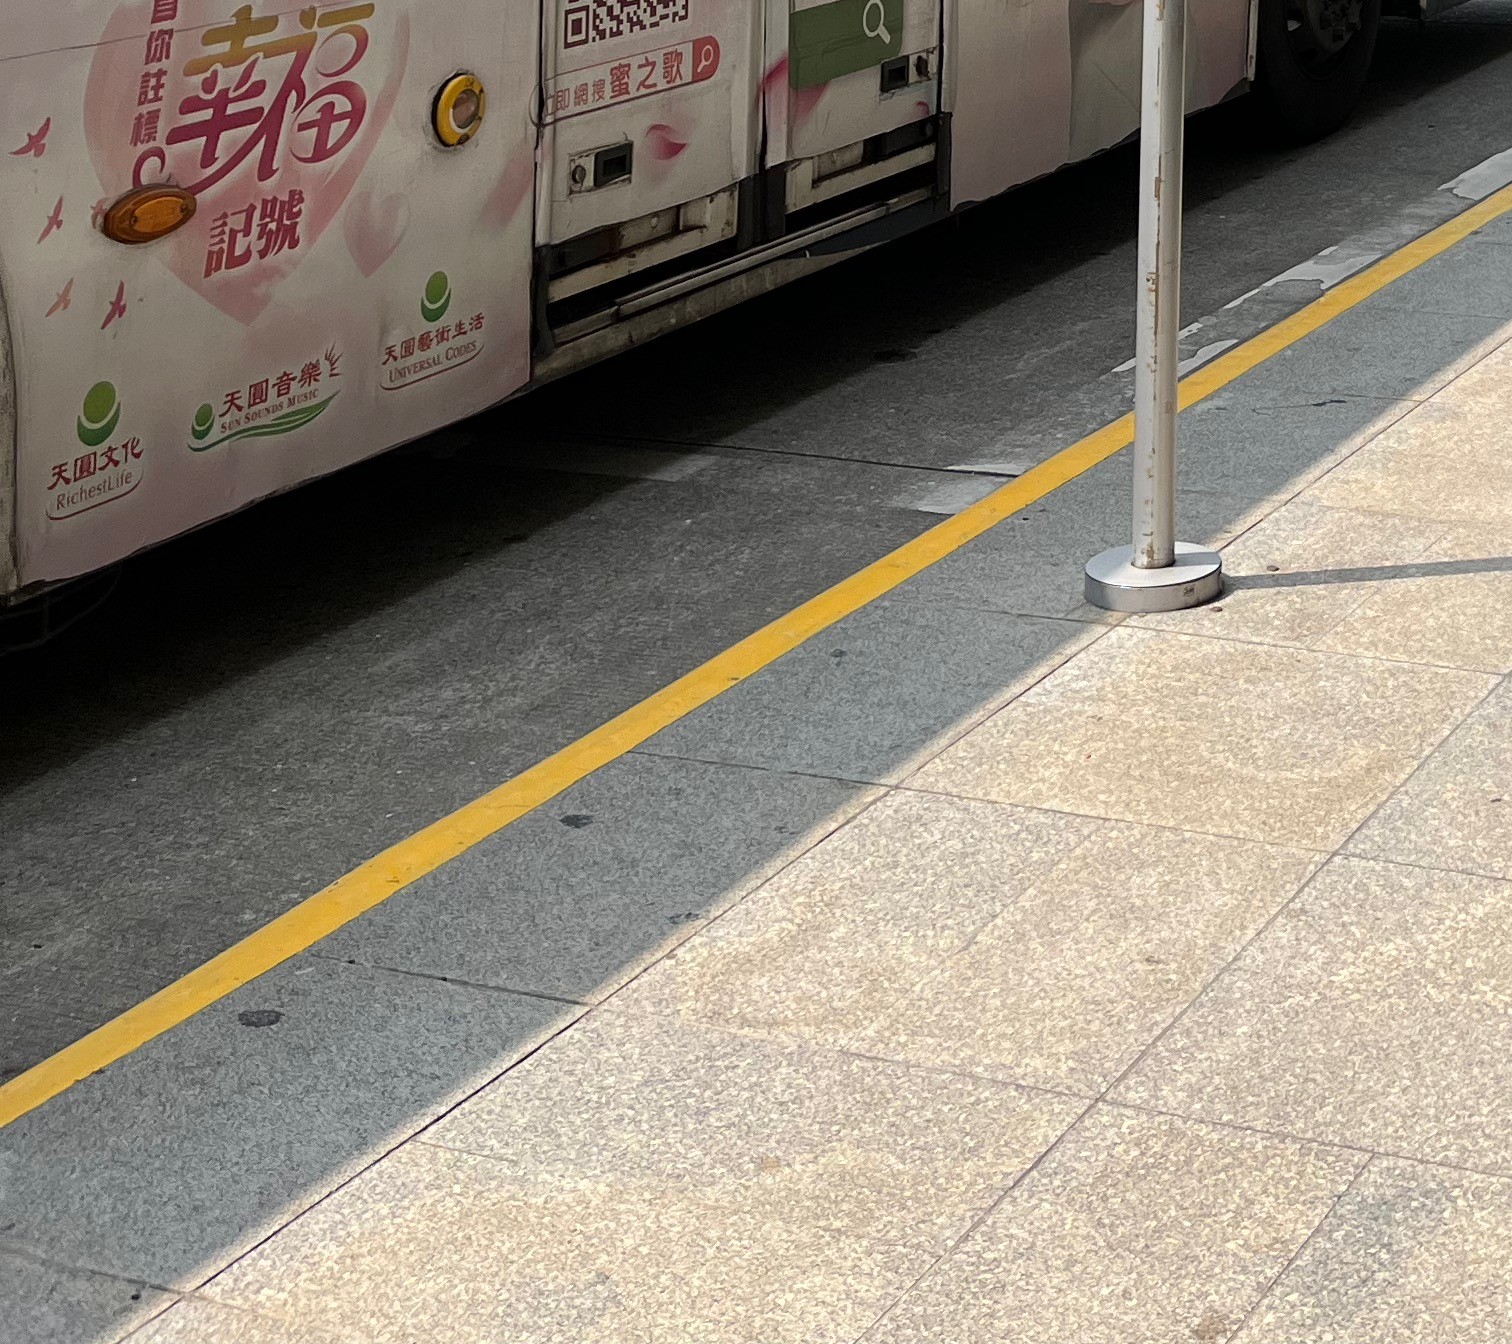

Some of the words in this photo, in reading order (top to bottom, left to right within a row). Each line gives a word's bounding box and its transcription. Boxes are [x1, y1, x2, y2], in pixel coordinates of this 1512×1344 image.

[204, 189, 304, 279] 記號
[219, 359, 322, 418] 天圓音樂
[47, 436, 144, 491] 天圓文化
[56, 470, 134, 511] RichestLife
